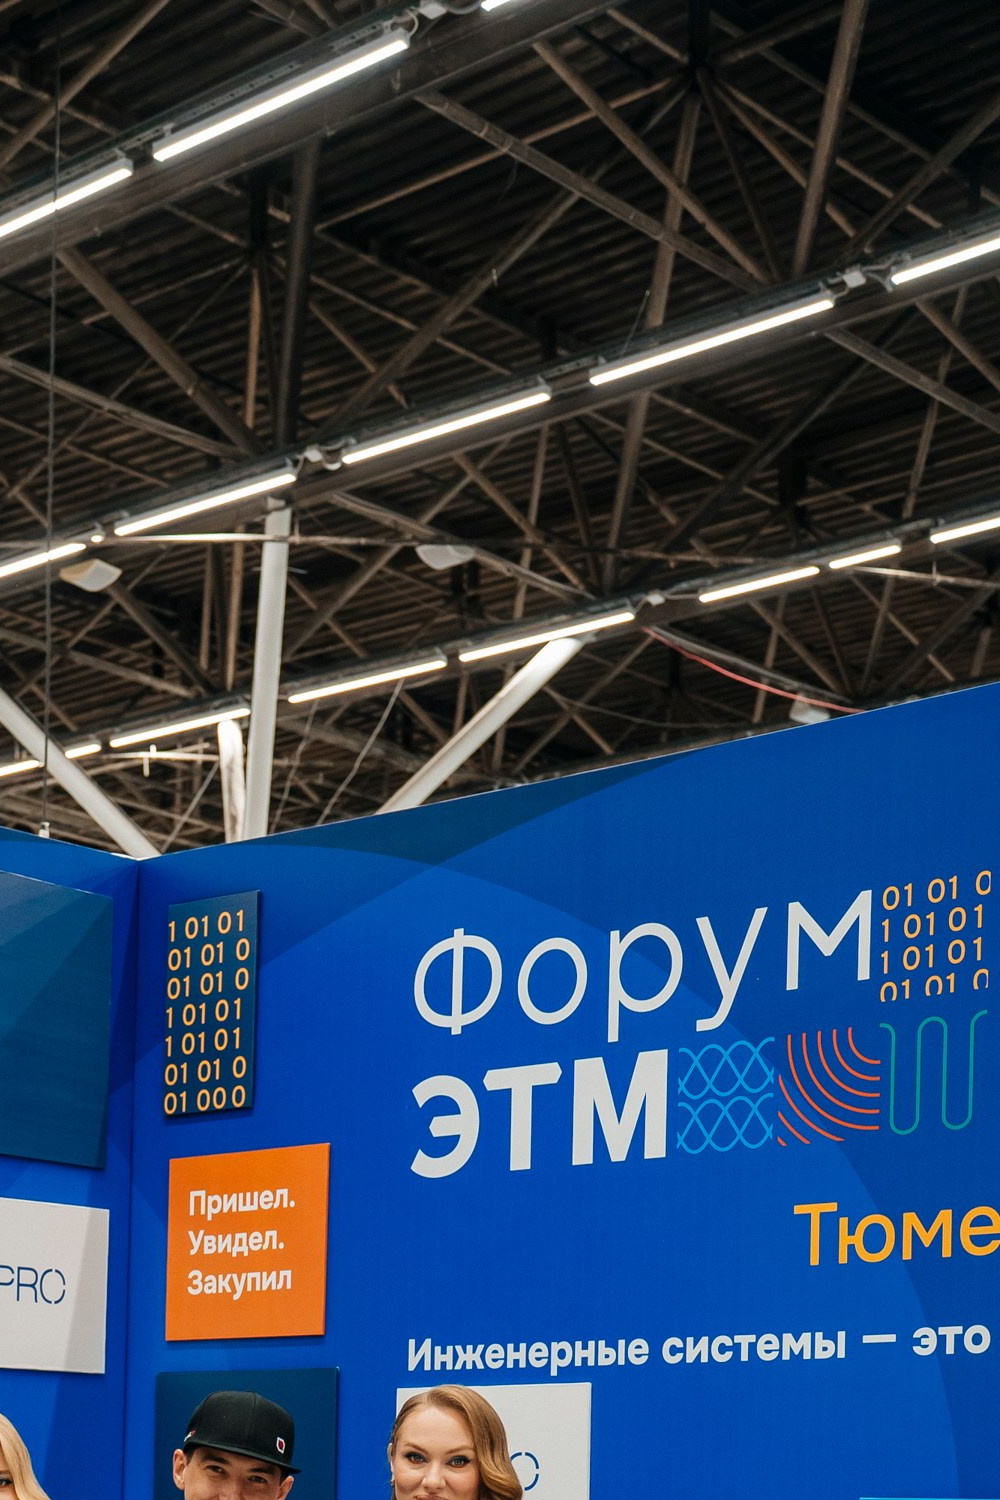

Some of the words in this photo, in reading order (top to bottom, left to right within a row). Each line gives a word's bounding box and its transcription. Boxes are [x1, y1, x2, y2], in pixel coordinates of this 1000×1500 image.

[412, 889, 873, 1043] Форум
[410, 1049, 669, 1179] ЭТМ
[188, 1188, 297, 1222] Пришел.
[187, 1229, 286, 1258] Увидел.
[793, 1201, 1000, 1266] Тюме
[187, 1268, 293, 1302] Закупил
[407, 1338, 649, 1377] Инженерные
[662, 1330, 847, 1364] системы
[912, 1324, 992, 1357] это
